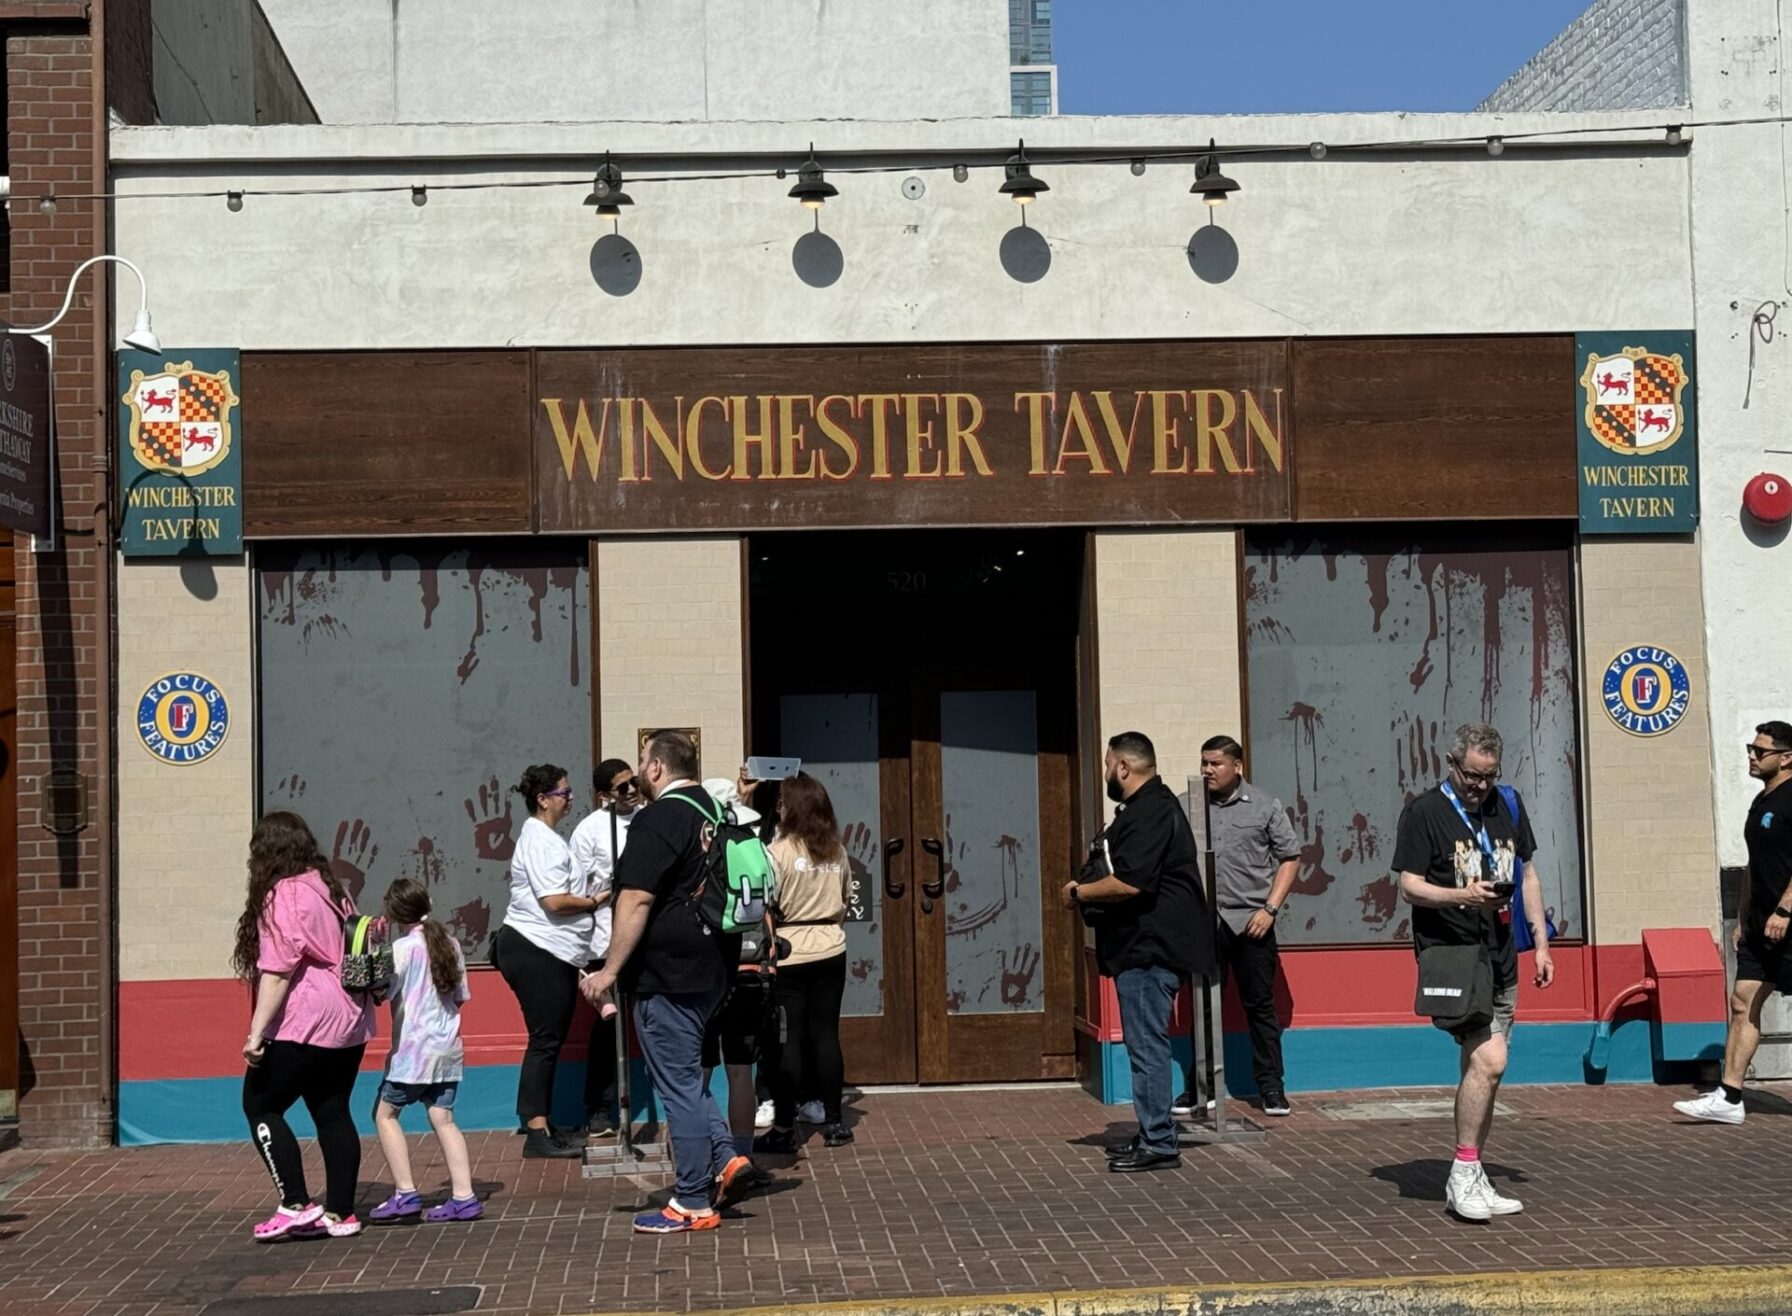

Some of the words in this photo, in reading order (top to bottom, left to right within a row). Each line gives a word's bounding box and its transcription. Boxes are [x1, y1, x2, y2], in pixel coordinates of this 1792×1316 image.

[541, 392, 993, 483] WINCHESTER
[1014, 388, 1285, 477] TAVERN
[1583, 465, 1690, 487] WINCHESTER
[125, 486, 236, 508] WINCHESTER
[1600, 497, 1675, 518] TAVERN
[142, 518, 220, 541] TAVERN
[887, 571, 927, 592] 520
[1610, 647, 1677, 675] FOCUS
[146, 675, 220, 704] FOCUS
[1605, 689, 1689, 732] FEATURES
[140, 720, 226, 760] FEATURES
